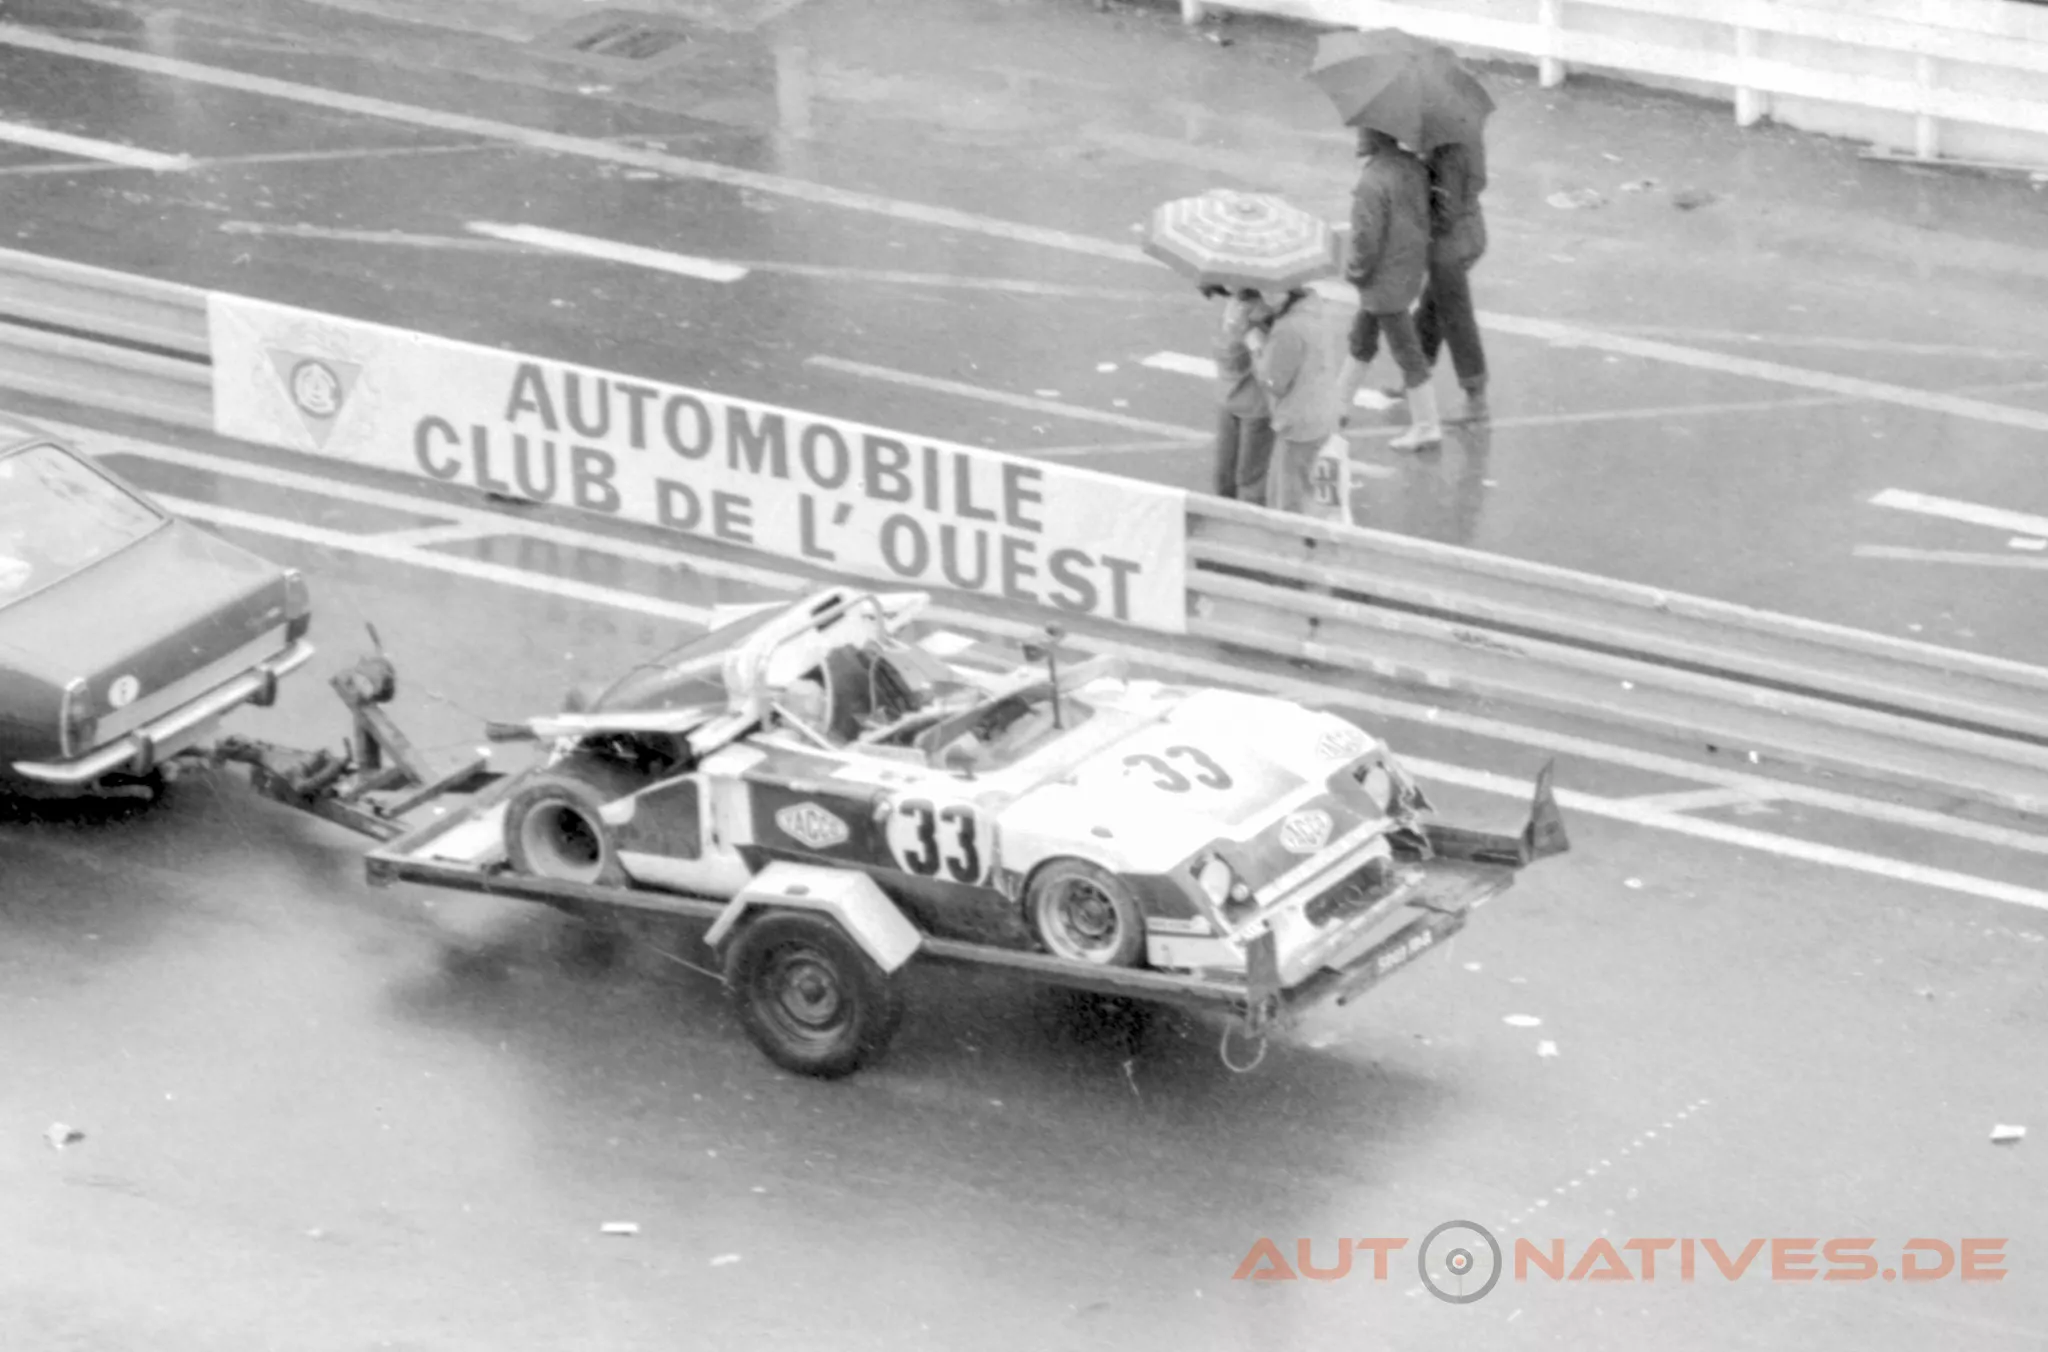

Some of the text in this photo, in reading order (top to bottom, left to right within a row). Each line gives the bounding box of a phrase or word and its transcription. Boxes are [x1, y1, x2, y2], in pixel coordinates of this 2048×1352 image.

[414, 414, 621, 513] CLUB
[656, 477, 753, 544] DE
[505, 362, 1043, 533] AUTOMOBILE
[1123, 744, 1233, 793] 33
[898, 797, 982, 885] 33
